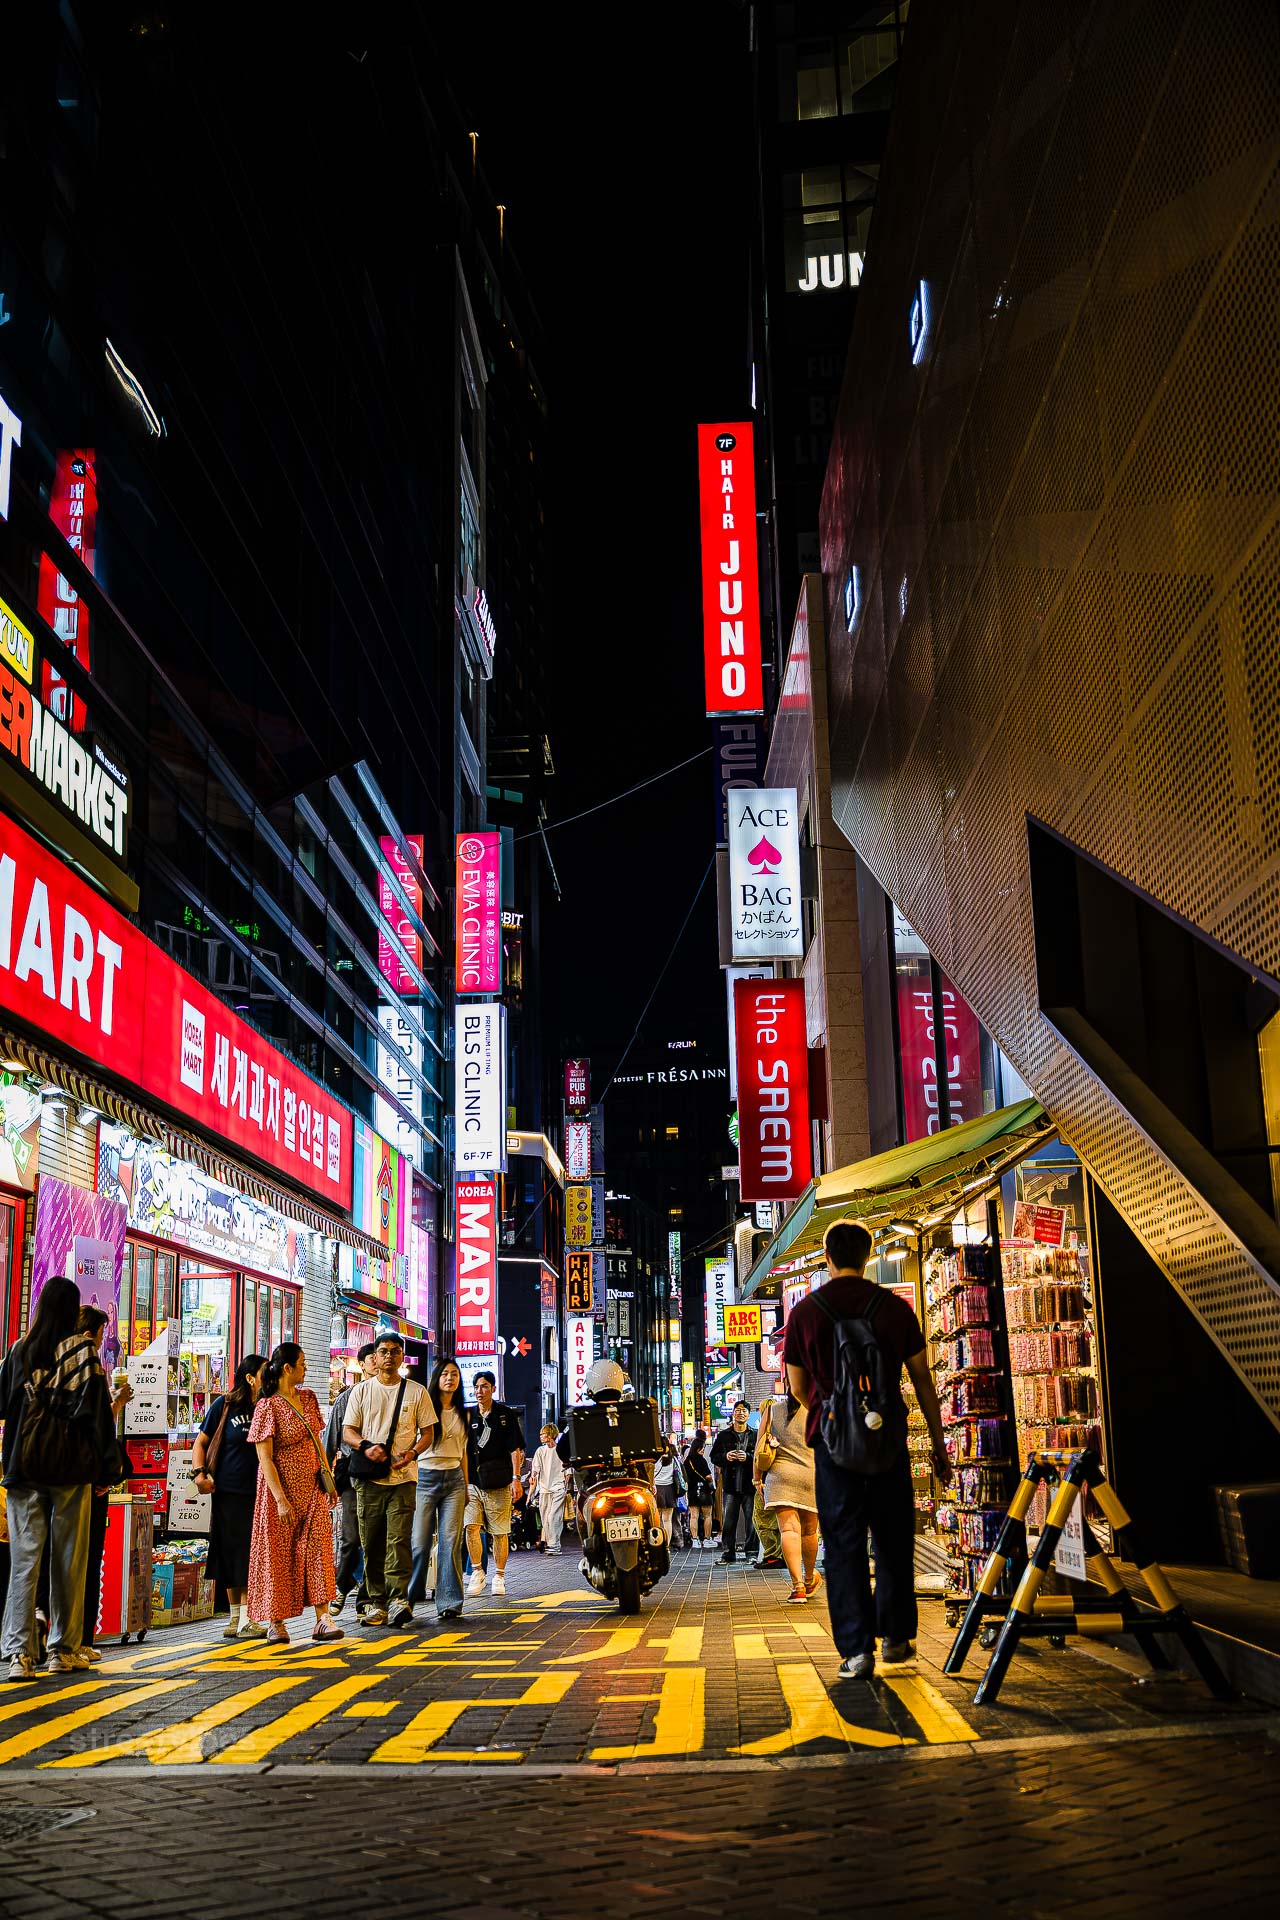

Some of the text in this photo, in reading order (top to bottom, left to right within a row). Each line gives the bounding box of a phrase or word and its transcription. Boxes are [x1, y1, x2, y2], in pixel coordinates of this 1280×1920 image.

[719, 438, 733, 448] 7F
[720, 459, 746, 698] HAIR JUNO
[738, 805, 789, 828] ACE
[740, 884, 792, 906] BAG
[741, 910, 792, 925] かばん
[462, 869, 481, 985] EVIA CLINIC
[734, 928, 800, 939] セレクトショップ
[755, 994, 786, 1044] the
[184, 1018, 203, 1050] KOREA
[183, 1047, 203, 1078] MART
[465, 1016, 481, 1132] BLS CLINIC
[647, 1067, 699, 1083] FRÉSA
[702, 1068, 727, 1079] INN
[569, 1082, 586, 1092] PUB
[569, 1095, 586, 1105] BAR
[457, 1186, 494, 1198] KOREA
[459, 1203, 491, 1333] MART
[765, 1286, 776, 1295] 2F
[728, 1311, 758, 1326] ABC
[728, 1325, 758, 1337] MART
[136, 1376, 157, 1384] ZERO
[134, 1415, 155, 1423] ZERO
[178, 1513, 200, 1521] ZERO
[609, 1527, 639, 1539] 8114
